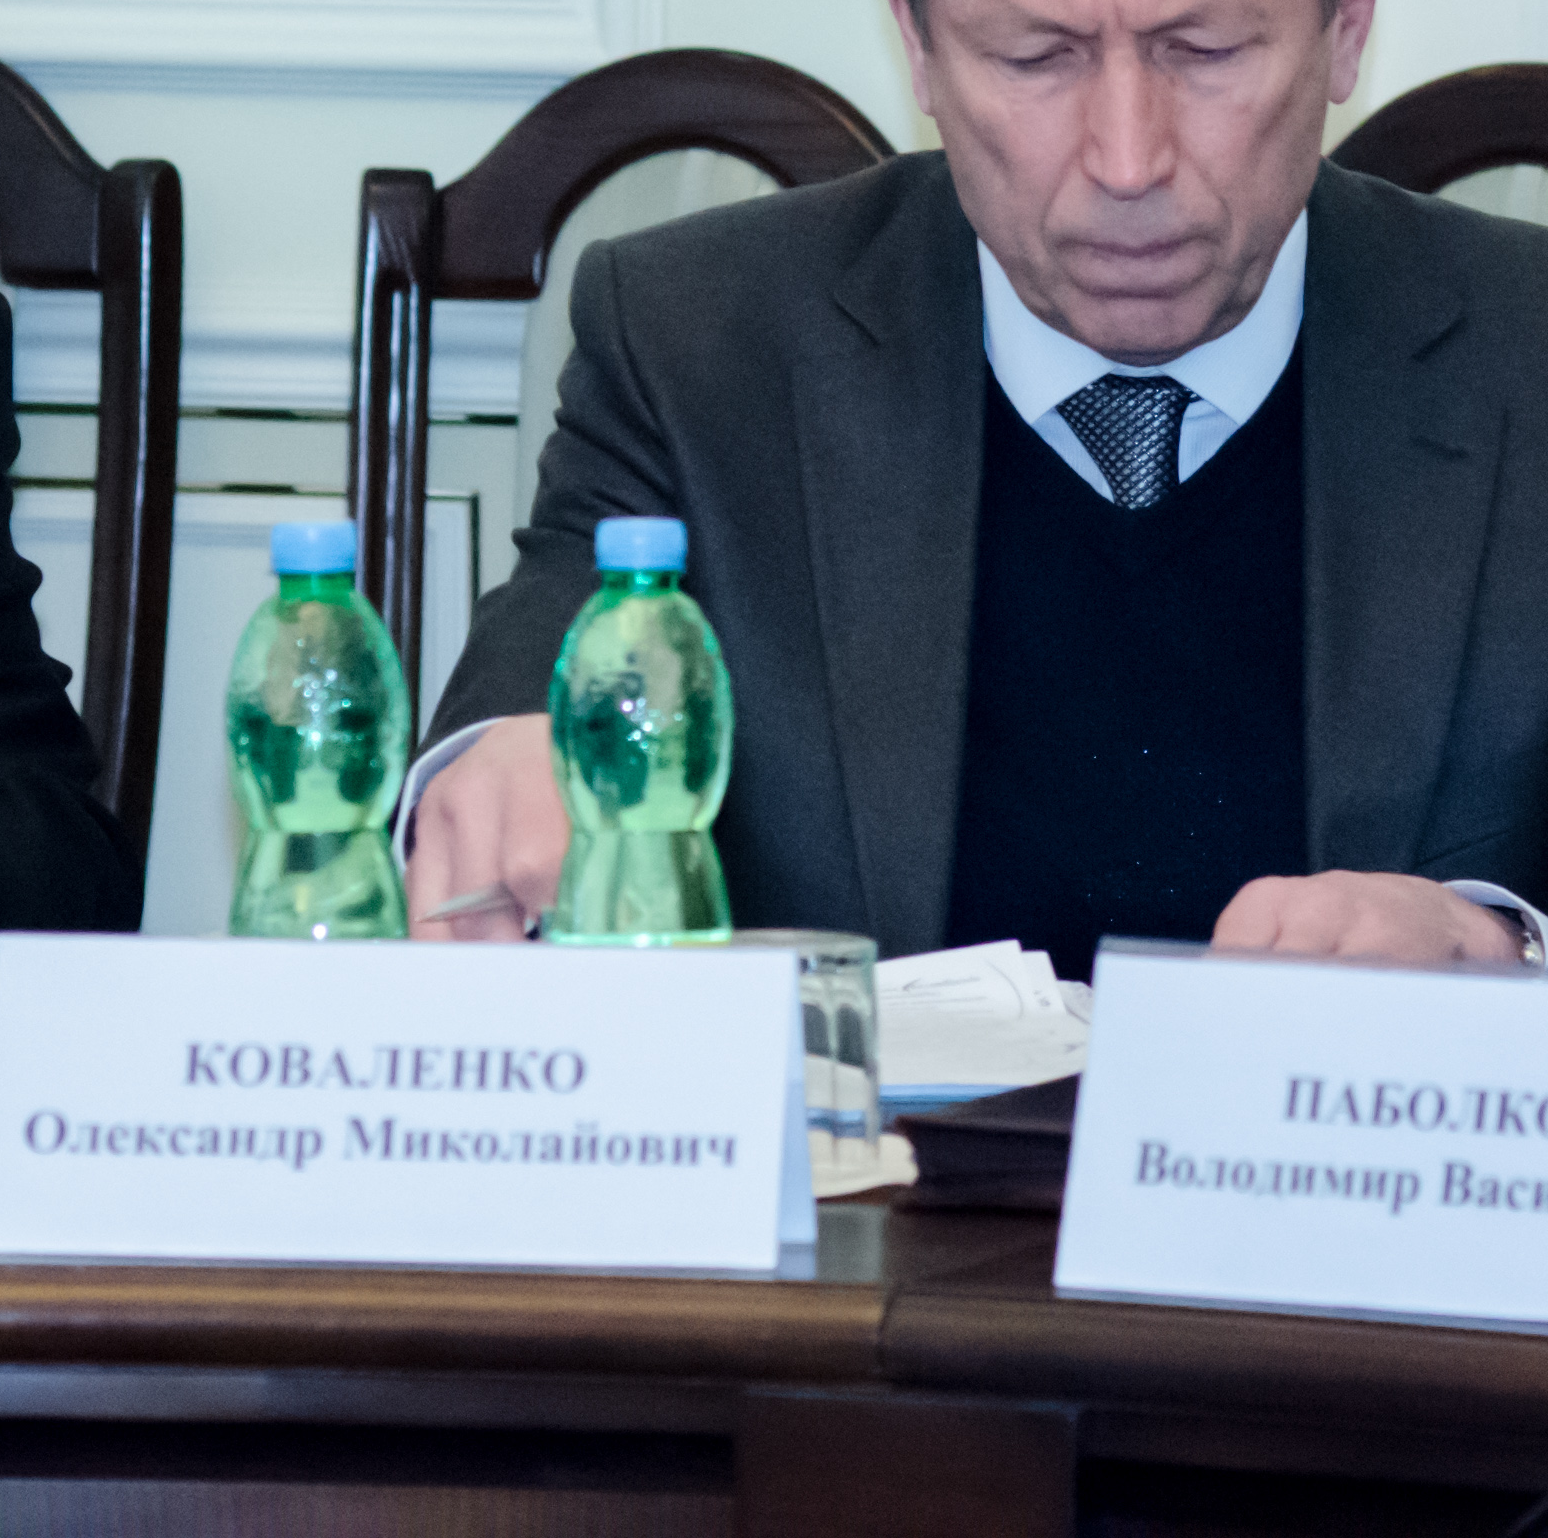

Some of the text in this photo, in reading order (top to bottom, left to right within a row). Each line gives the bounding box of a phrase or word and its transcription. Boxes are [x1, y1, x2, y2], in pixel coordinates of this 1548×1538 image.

[184, 1041, 589, 1092] КОВАЛЕНКО
[22, 1110, 738, 1171] Олександр Миколайович
[1134, 1139, 1422, 1216] Володимир
